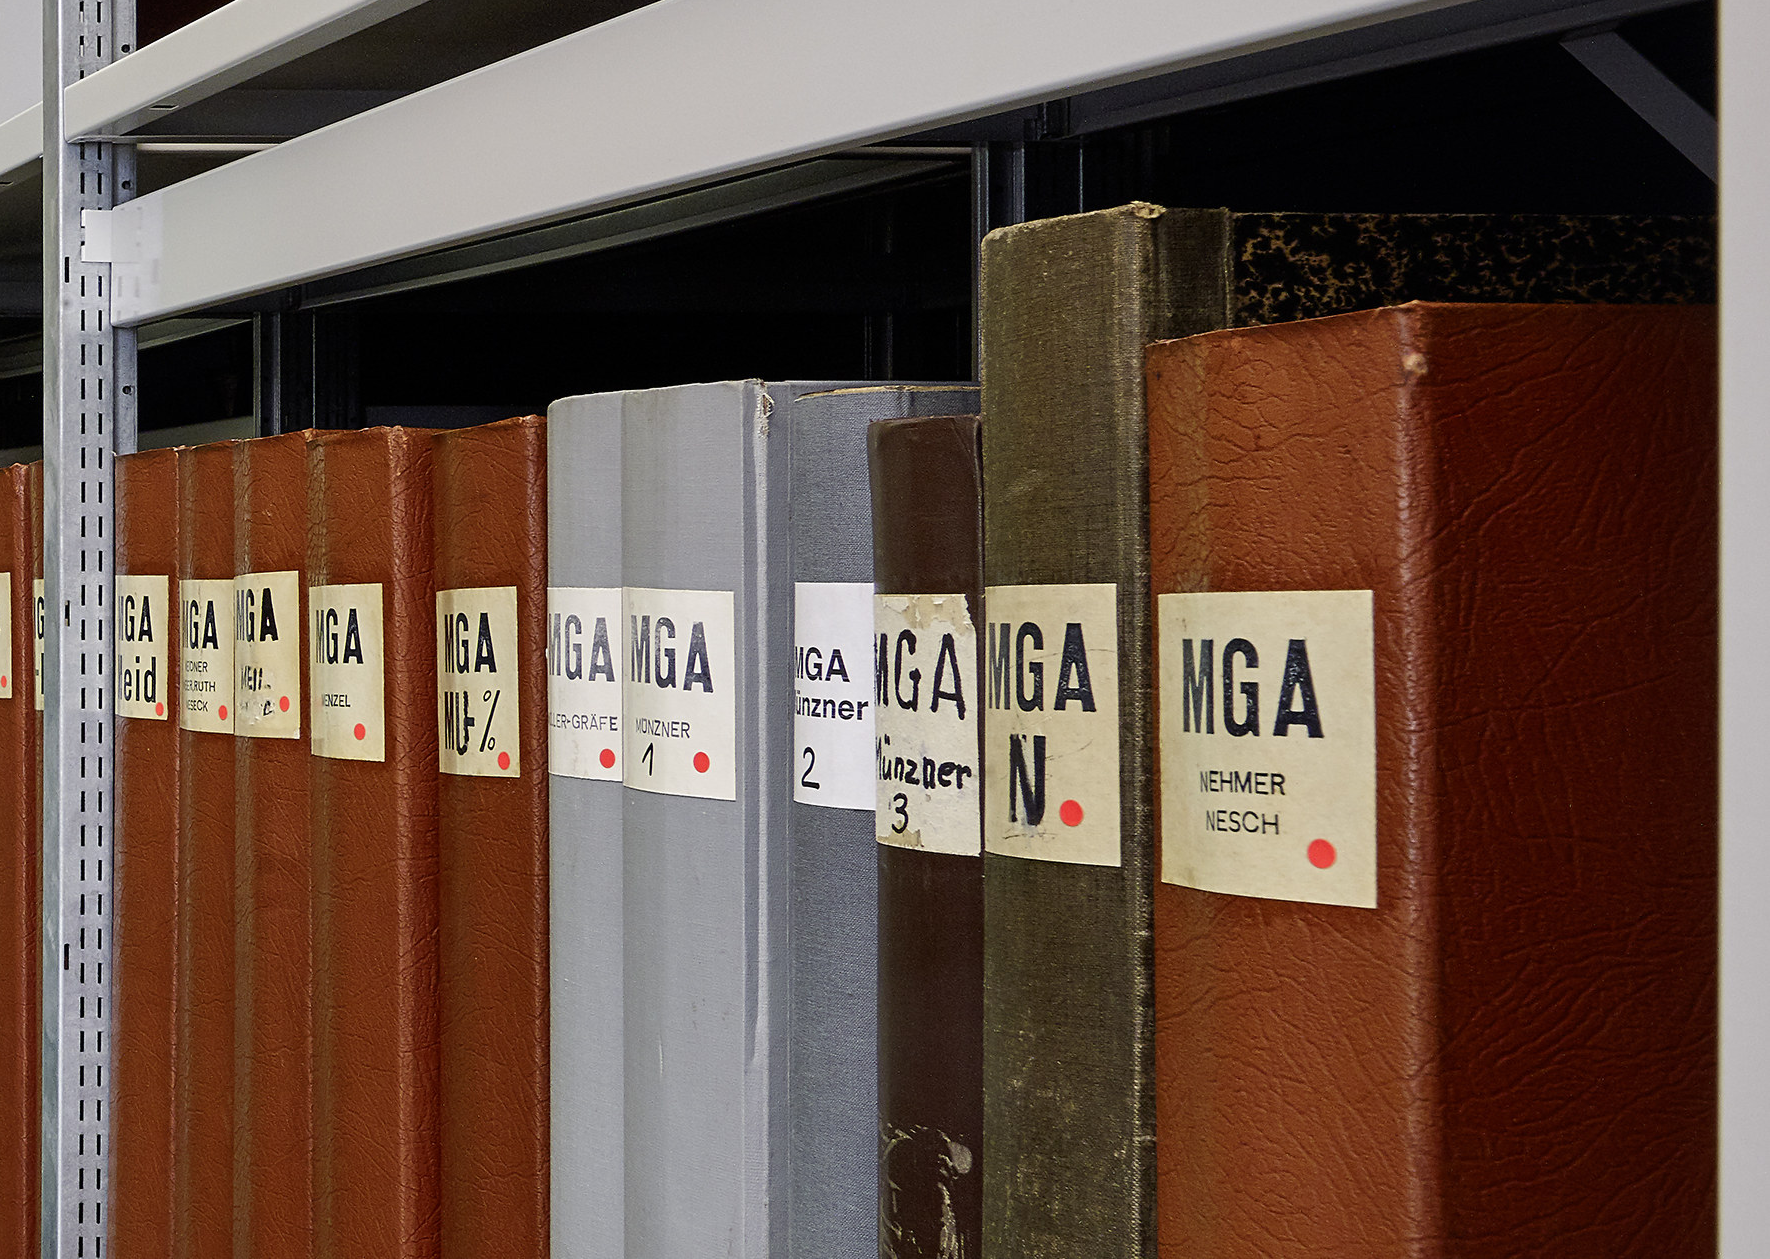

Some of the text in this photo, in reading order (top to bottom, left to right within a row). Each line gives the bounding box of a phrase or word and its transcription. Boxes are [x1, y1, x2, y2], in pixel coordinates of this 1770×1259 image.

[236, 587, 279, 643] MGA
[315, 607, 364, 666] MGA
[444, 611, 498, 674] MGA
[548, 613, 616, 683] MGA
[630, 614, 714, 693] MGA
[988, 621, 1097, 713] MGA
[794, 692, 869, 722] ünzner
[1182, 637, 1325, 739] MGA
[549, 712, 618, 732] LLER-GRÄFE
[635, 716, 691, 740] MÜNZNER
[641, 742, 655, 777] 1
[800, 746, 821, 790] 2
[1008, 733, 1047, 826] N
[1199, 770, 1287, 797] NEHMER
[891, 793, 909, 834] 3
[1205, 809, 1280, 836] NESCH
